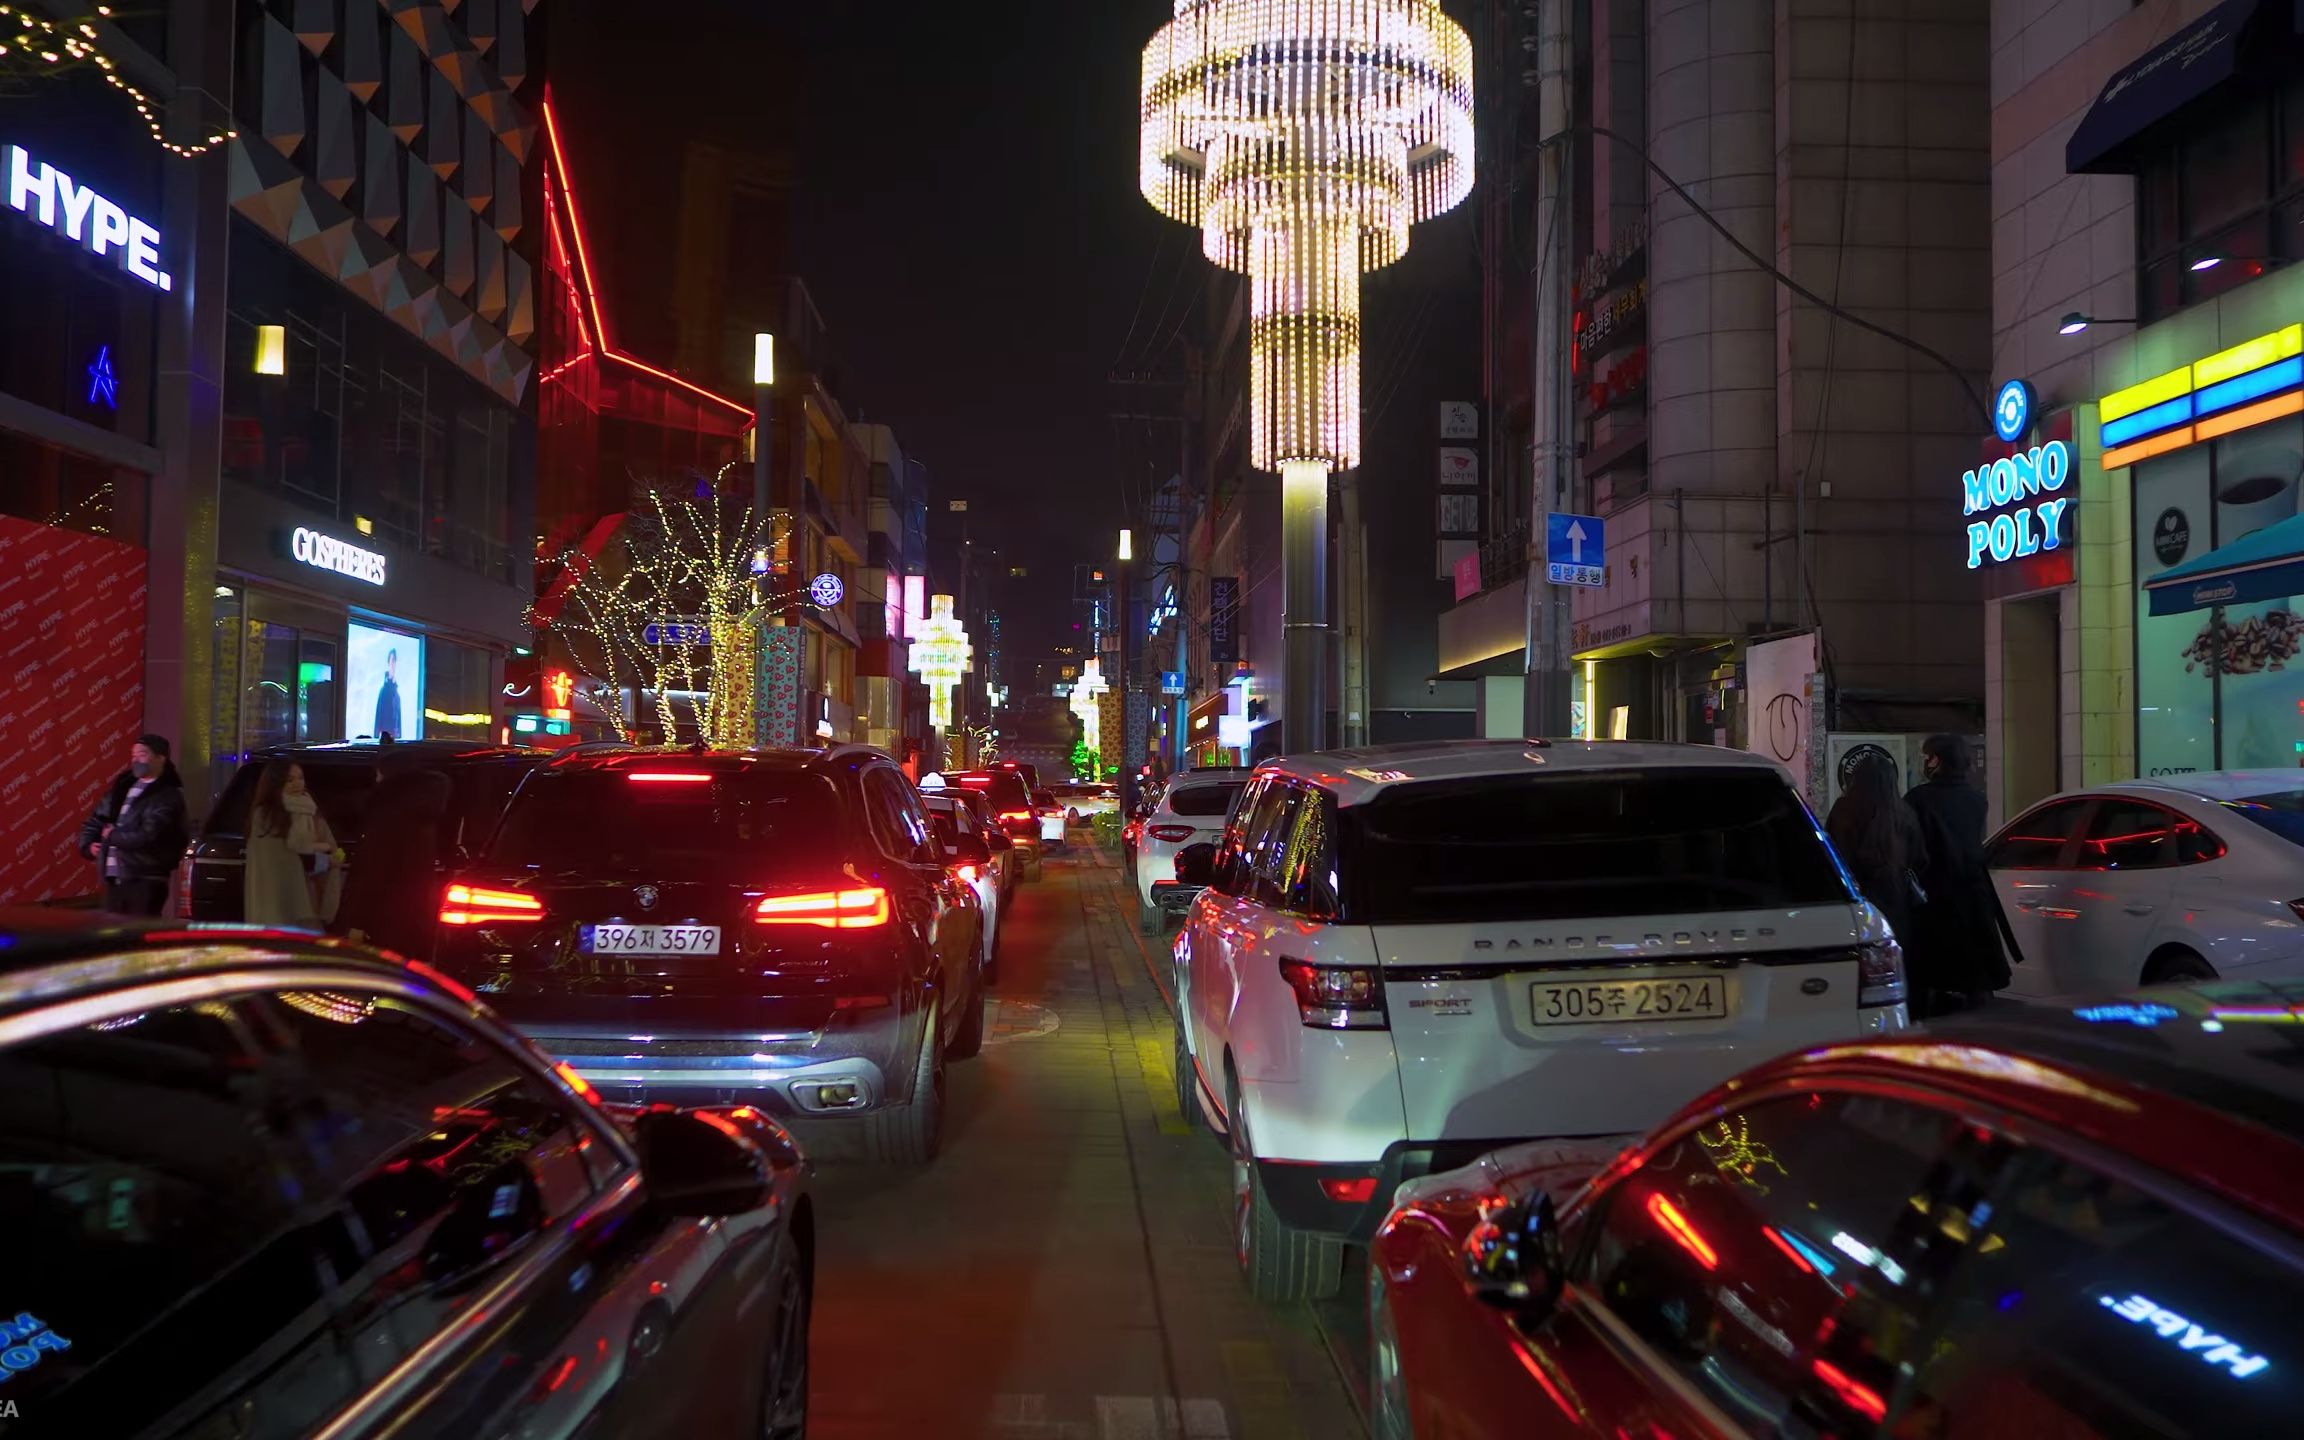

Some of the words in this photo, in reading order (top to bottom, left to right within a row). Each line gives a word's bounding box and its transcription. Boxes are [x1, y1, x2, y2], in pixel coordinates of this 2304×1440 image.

[8, 144, 174, 292] HYPE.
[1963, 440, 2069, 516] MONO
[1967, 497, 2067, 569] POLY
[293, 526, 386, 586] GOSPHERES
[1550, 564, 1601, 585] 일방통행
[596, 928, 655, 950] 396저
[660, 928, 716, 950] 3579
[1643, 927, 1777, 946] ROVER
[1409, 998, 1473, 1009] SPORT
[1545, 986, 1627, 1018] 305주
[1634, 982, 1714, 1015] 2524
